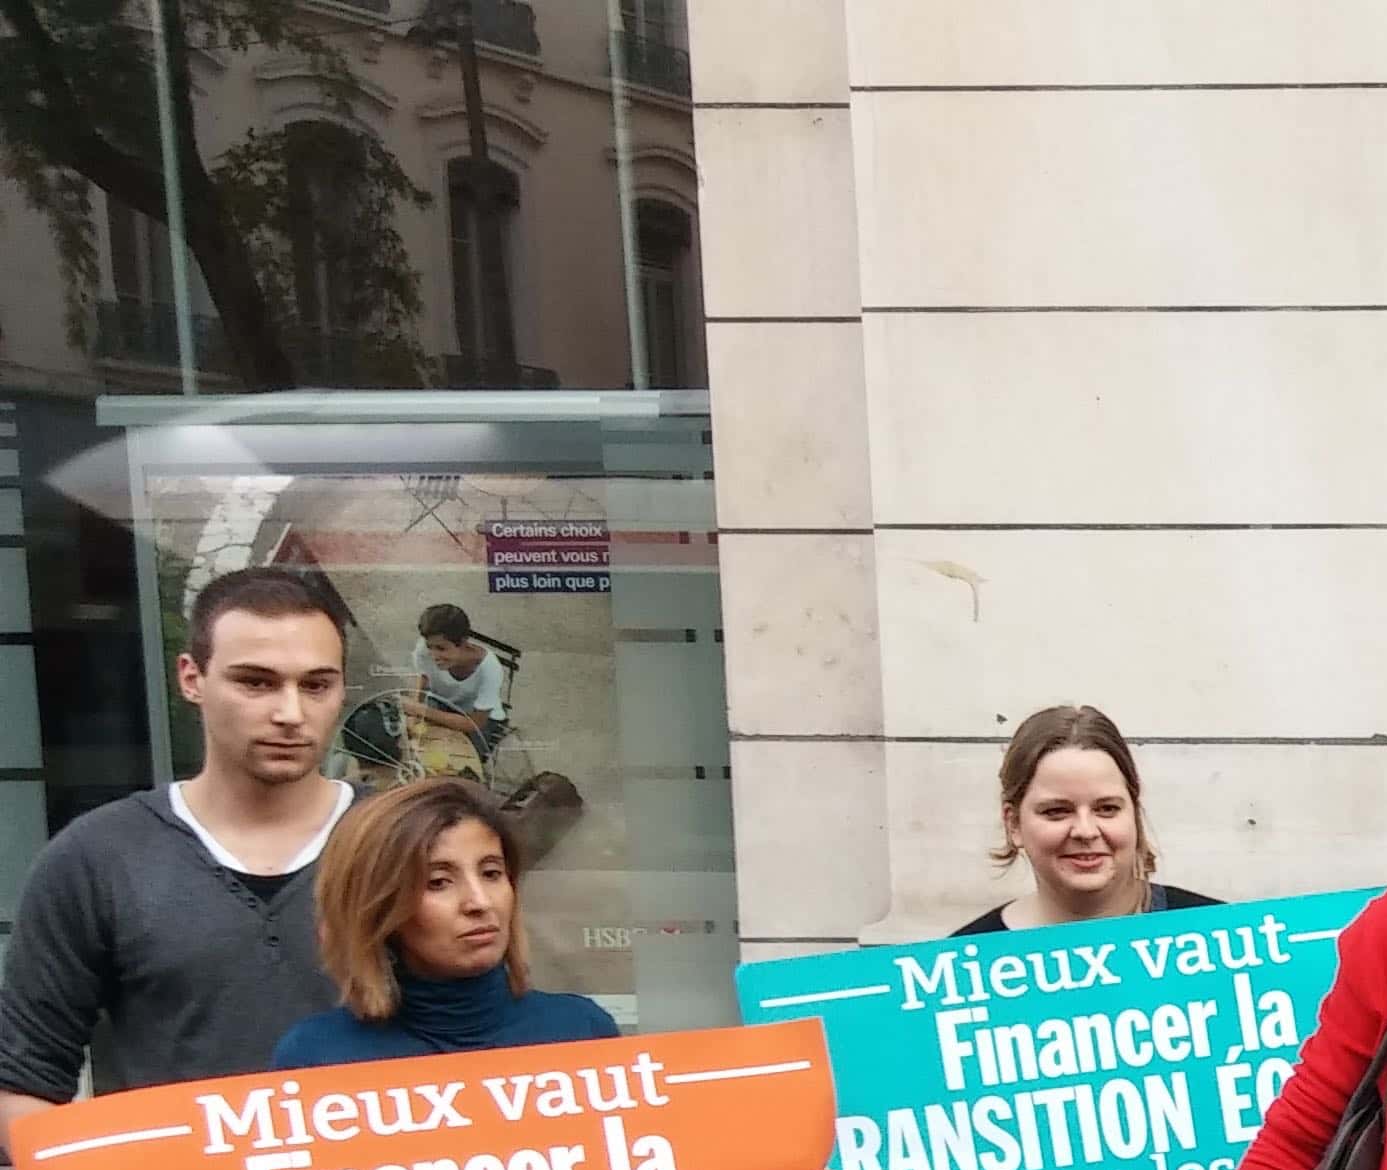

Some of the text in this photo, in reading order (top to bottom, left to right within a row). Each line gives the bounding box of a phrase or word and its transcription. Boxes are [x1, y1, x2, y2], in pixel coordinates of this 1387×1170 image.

[491, 522, 602, 538] Certains choix
[494, 550, 558, 566] peuvent
[560, 550, 601, 564] vous
[495, 574, 529, 590] plus
[532, 573, 562, 588] loin
[565, 576, 595, 591] que
[895, 915, 1290, 1009] Mieux vaut
[936, 974, 1298, 1090] Financer la
[197, 1053, 669, 1154] Mieux vaut
